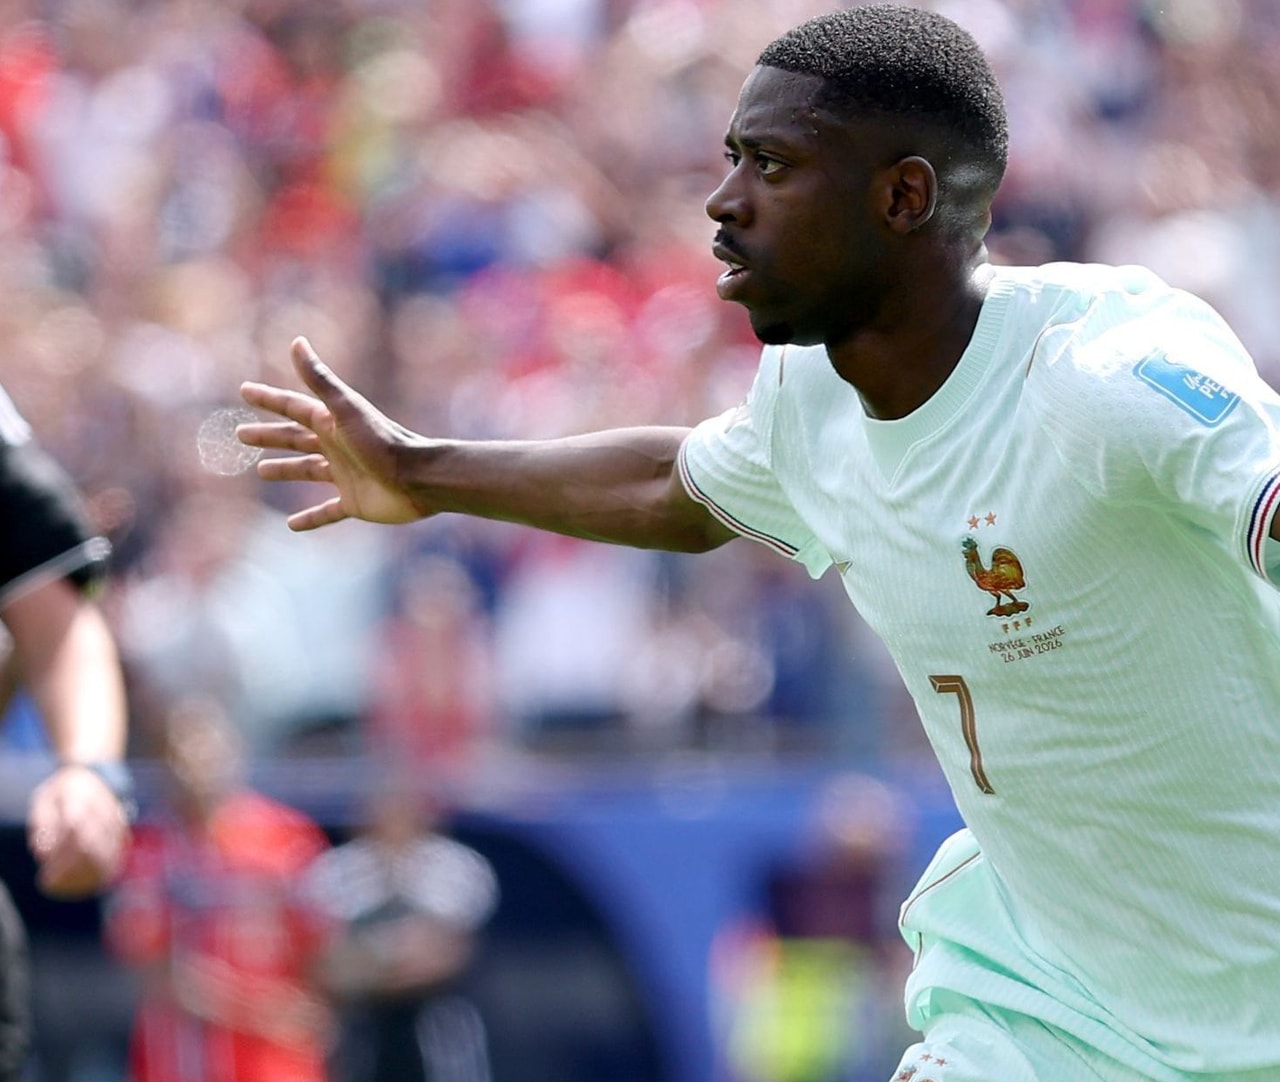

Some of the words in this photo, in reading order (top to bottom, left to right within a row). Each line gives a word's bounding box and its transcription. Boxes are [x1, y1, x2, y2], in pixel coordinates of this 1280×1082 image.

[1031, 625, 1065, 643] FRANCE
[1001, 652, 1015, 663] 26
[1017, 647, 1035, 660] JUIN
[1035, 639, 1063, 654] 2026
[927, 674, 995, 795] 7
